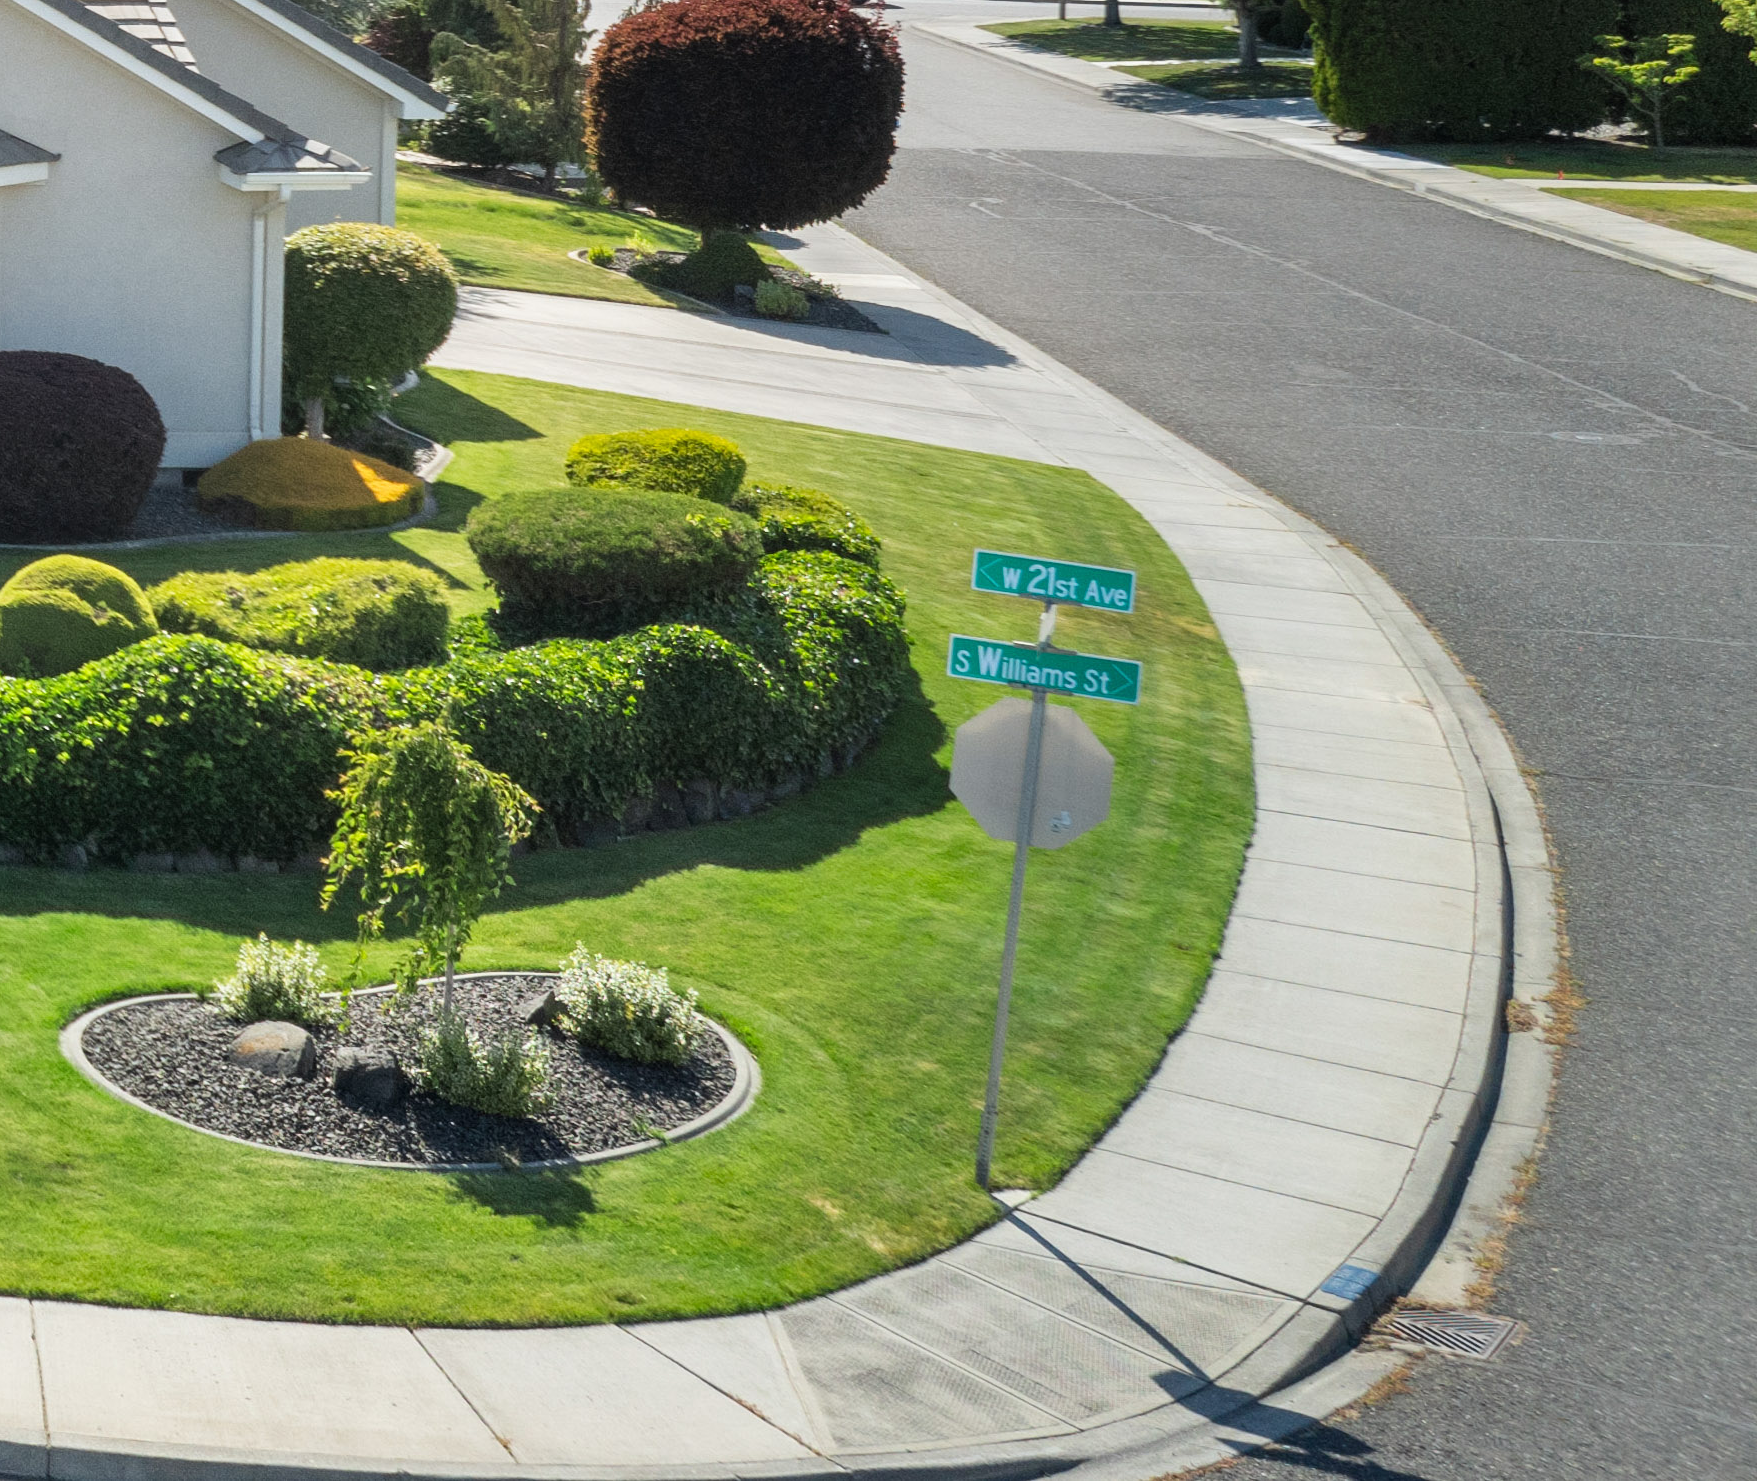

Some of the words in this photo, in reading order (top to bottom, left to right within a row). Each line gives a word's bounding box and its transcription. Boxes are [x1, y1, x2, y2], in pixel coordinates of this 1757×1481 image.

[1002, 566, 1022, 590] W
[1026, 564, 1079, 599] 21st
[1084, 579, 1128, 607] Ave
[955, 649, 971, 673] S
[978, 645, 1077, 689] Williams
[1083, 669, 1110, 694] St
